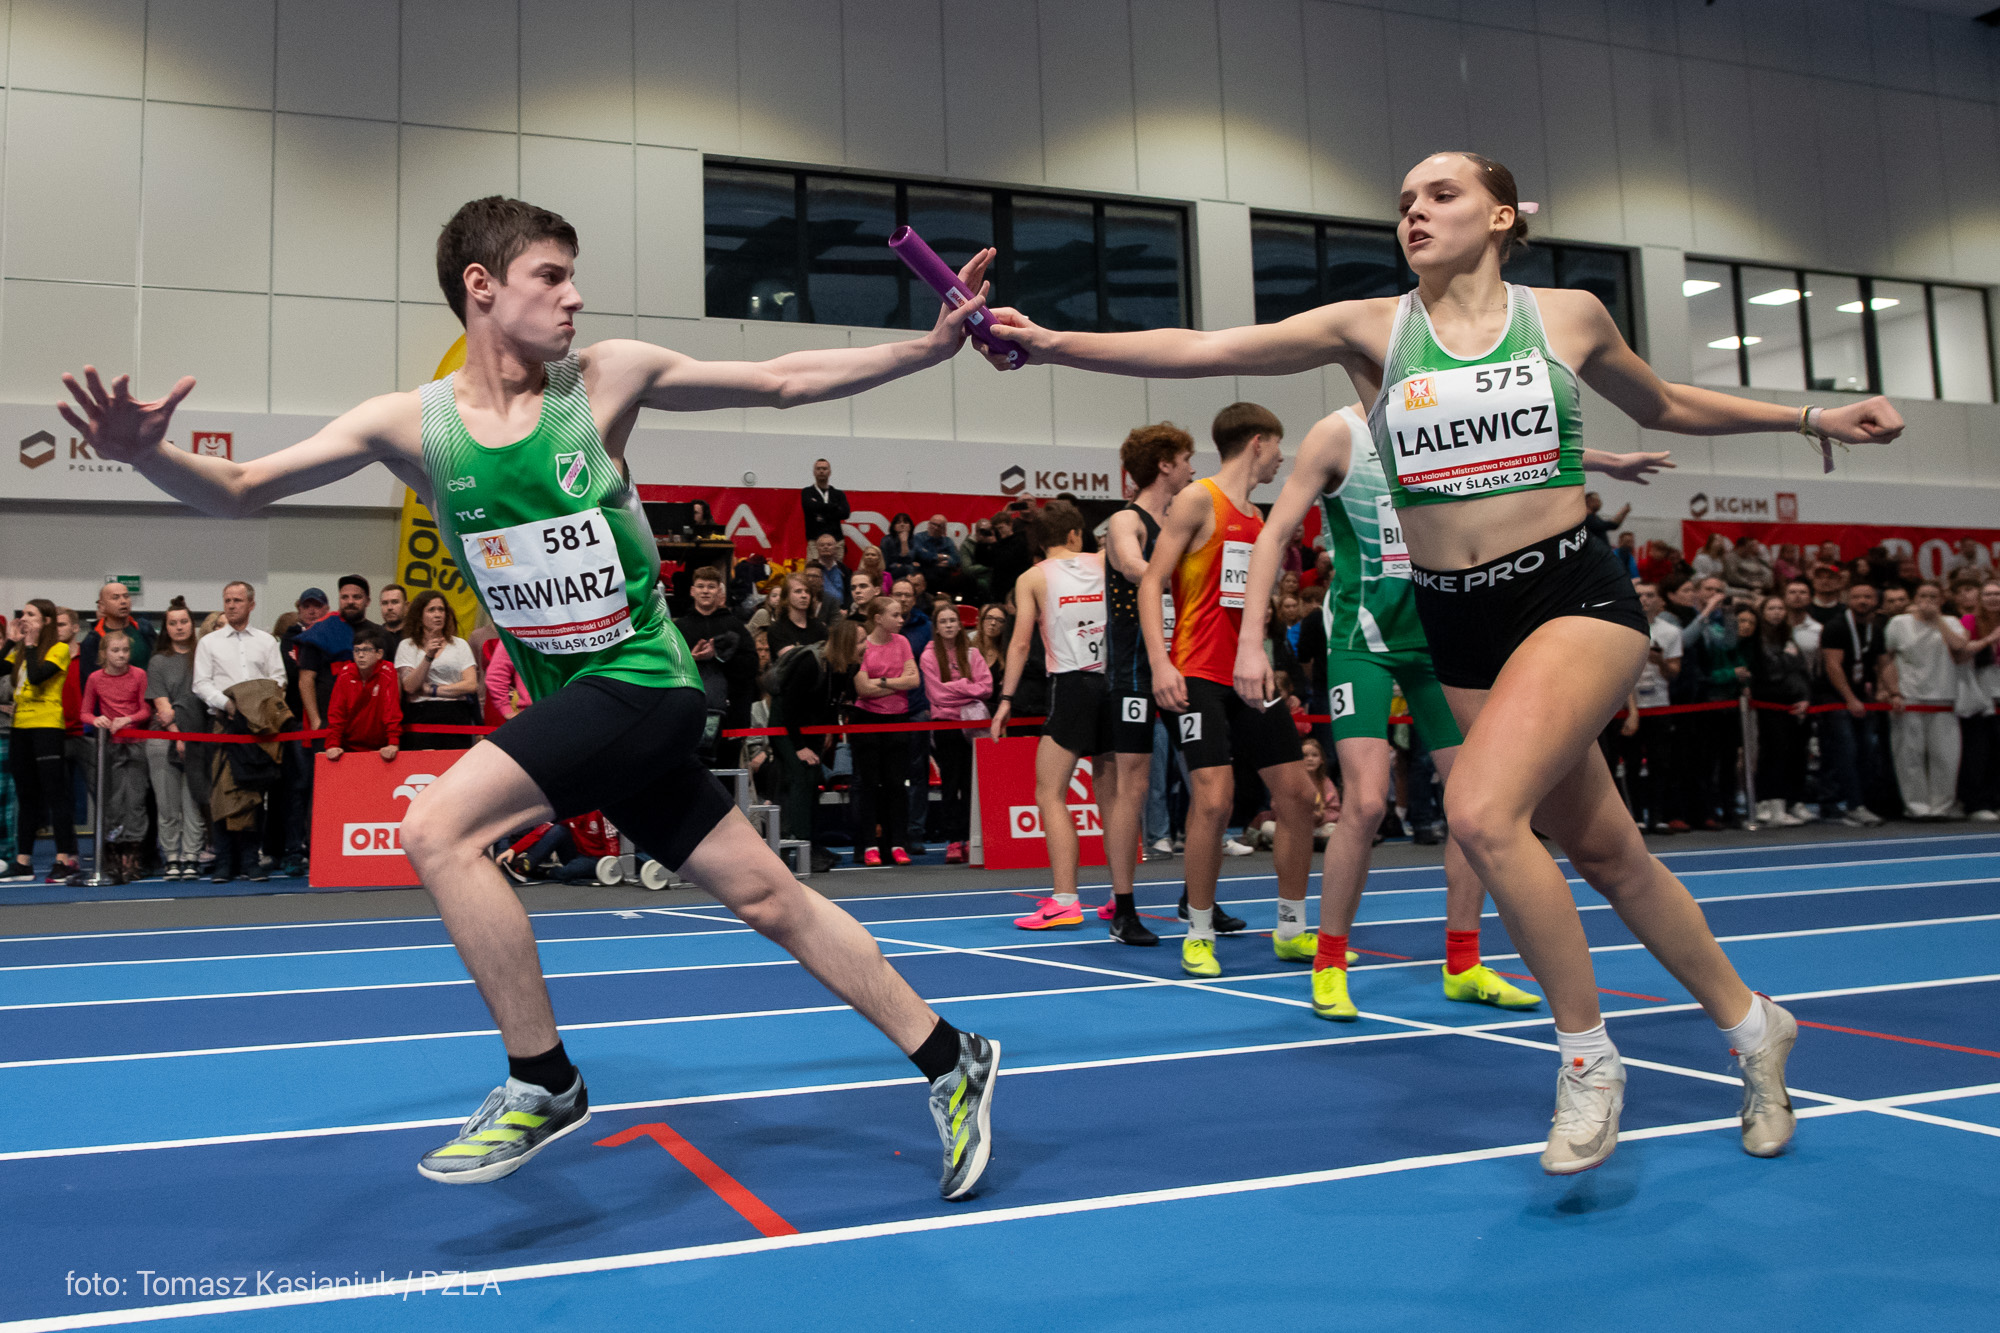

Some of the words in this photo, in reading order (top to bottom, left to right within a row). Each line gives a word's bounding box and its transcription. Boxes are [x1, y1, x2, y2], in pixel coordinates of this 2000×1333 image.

[1476, 365, 1533, 393] 575
[1406, 397, 1436, 409] PZLA
[1397, 405, 1552, 457] LALEWICZ
[69, 464, 123, 473] POLSKA
[1403, 475, 1421, 484] PZLA
[1421, 470, 1450, 480] Halowe
[1451, 463, 1498, 476] Mistrzostwa
[1499, 457, 1523, 468] Polski
[1524, 455, 1537, 464] U18
[1543, 451, 1558, 460] U20
[1466, 473, 1510, 489] ŚLĄSK
[1513, 467, 1549, 482] 2024
[447, 475, 477, 492] esa
[1035, 470, 1109, 491] KGHM
[455, 508, 486, 521] TLC
[543, 520, 600, 554] 581
[486, 556, 512, 567] PZLA
[1464, 550, 1545, 593] PRO
[487, 566, 620, 611] STAWIARZ
[597, 618, 611, 628] U18
[552, 638, 588, 651] ŚLĄSK
[589, 628, 621, 647] 2024
[1088, 641, 1104, 662] 9
[1128, 700, 1141, 719] 6
[1332, 688, 1346, 715] 3
[1183, 715, 1195, 740] 2
[1017, 809, 1103, 833] OEN
